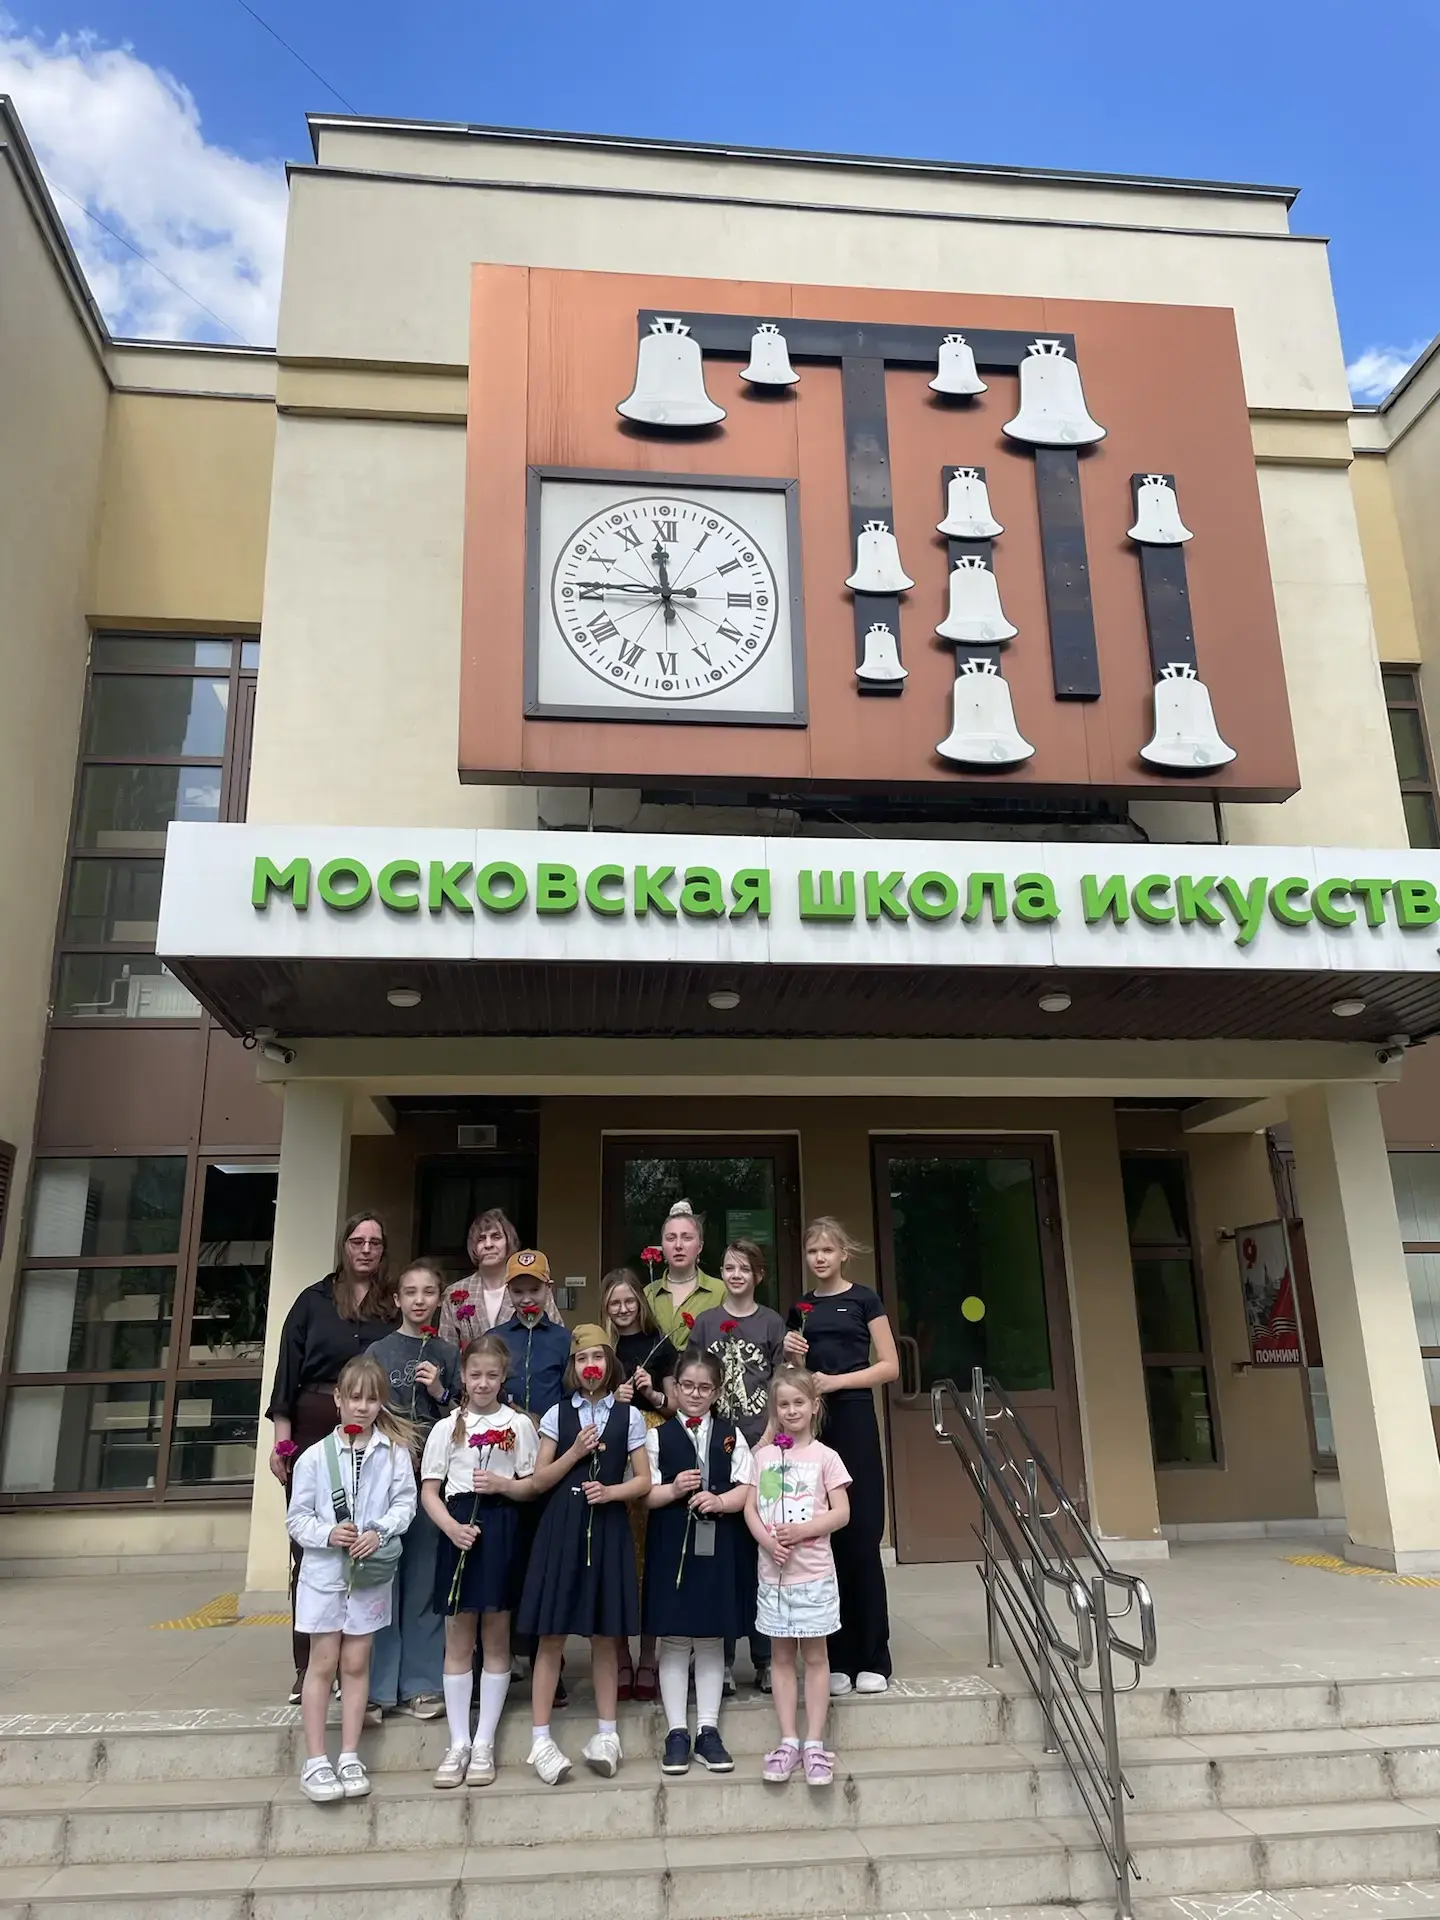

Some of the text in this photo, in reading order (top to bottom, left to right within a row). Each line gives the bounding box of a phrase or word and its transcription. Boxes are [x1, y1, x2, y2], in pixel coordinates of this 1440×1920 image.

[613, 525, 644, 552] XI
[652, 520, 679, 543] XII
[693, 532, 712, 553] I
[587, 549, 617, 572] X
[716, 557, 743, 577] II
[727, 592, 752, 609] III
[586, 610, 620, 645] VIII
[716, 618, 744, 646] IV
[617, 638, 647, 669] VII
[656, 652, 679, 676] VI
[692, 643, 713, 667] V
[1256, 1349, 1299, 1363] ПОМНИМ!
